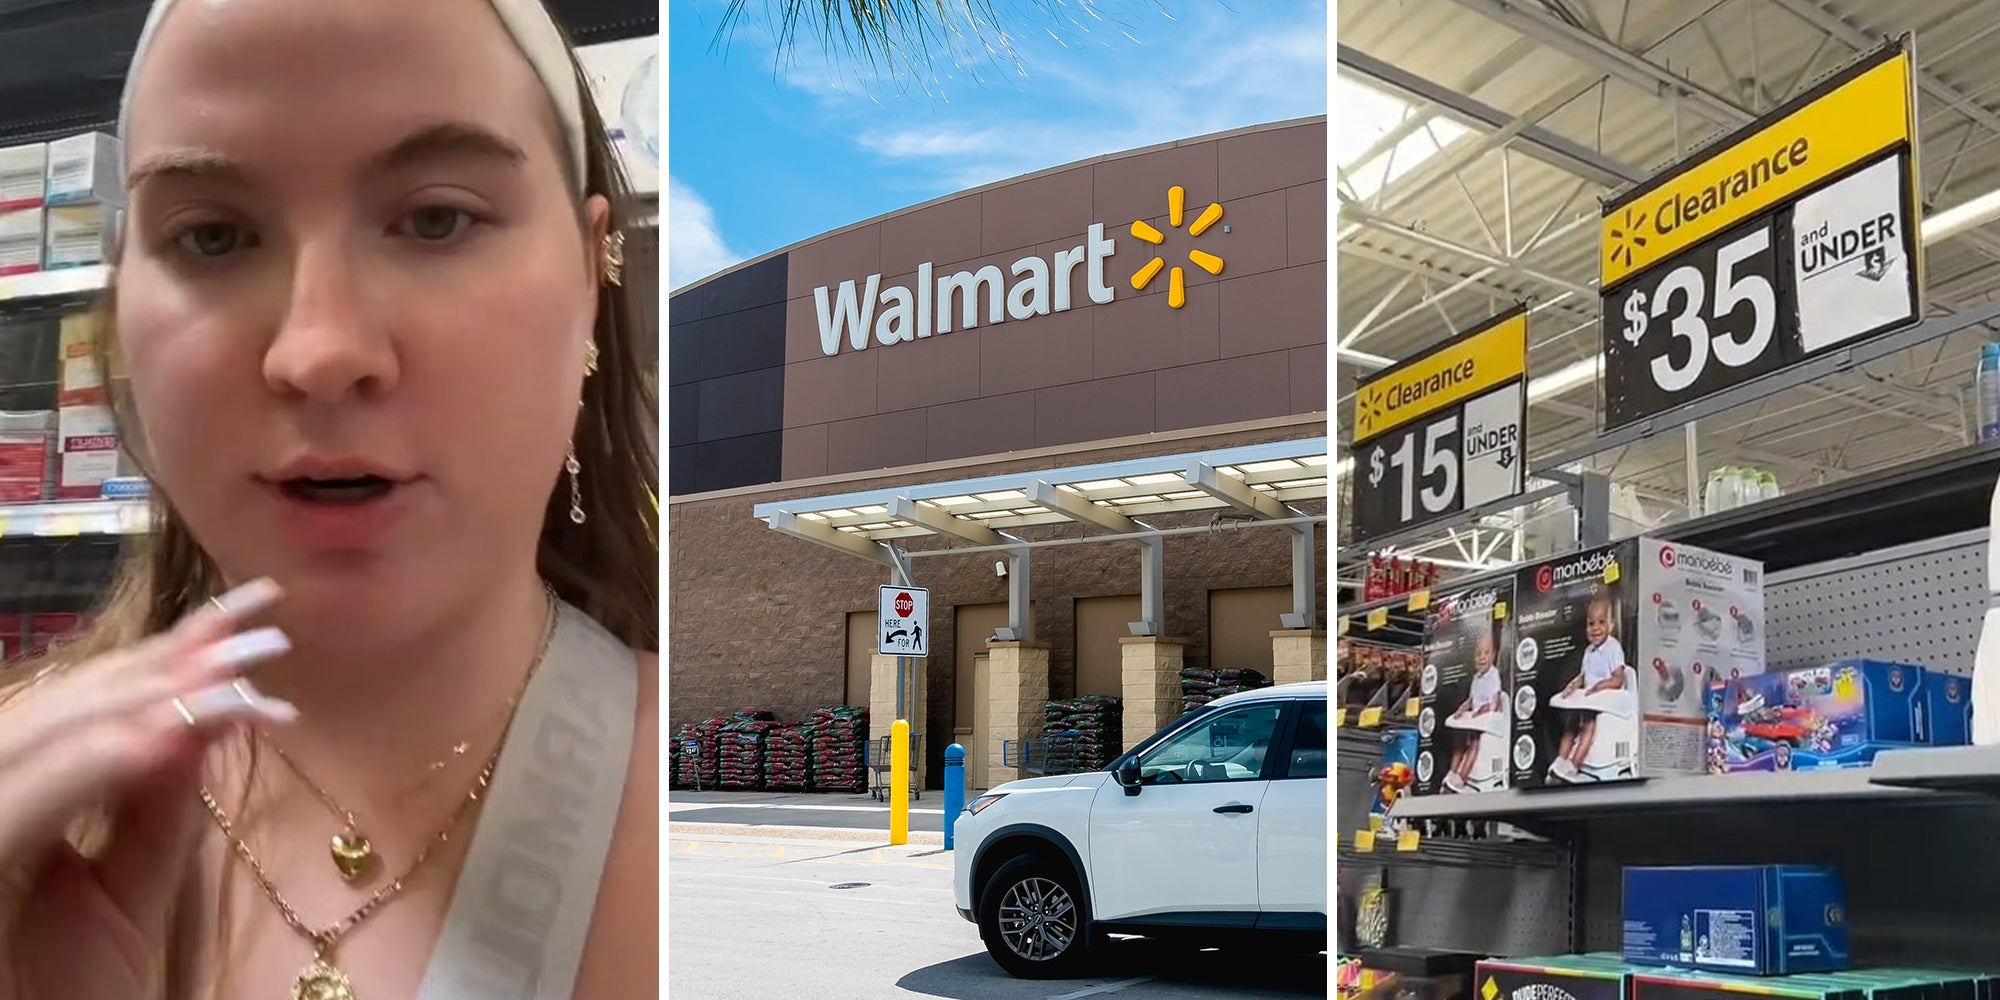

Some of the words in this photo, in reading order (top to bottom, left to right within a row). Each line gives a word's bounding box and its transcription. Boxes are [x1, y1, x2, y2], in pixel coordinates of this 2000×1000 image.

[1654, 137, 1808, 235] Clearance
[1800, 221, 1829, 248] and
[1801, 212, 1896, 272] UNDER
[814, 222, 1116, 356] Walmart
[1623, 226, 1776, 391] $35
[1386, 358, 1474, 411] Clearance
[1466, 422, 1484, 439] and
[1466, 424, 1518, 456] UNDER
[1369, 415, 1459, 524] $15
[884, 619, 901, 628] HERE
[895, 600, 913, 610] STOP
[897, 638, 910, 648] FOR
